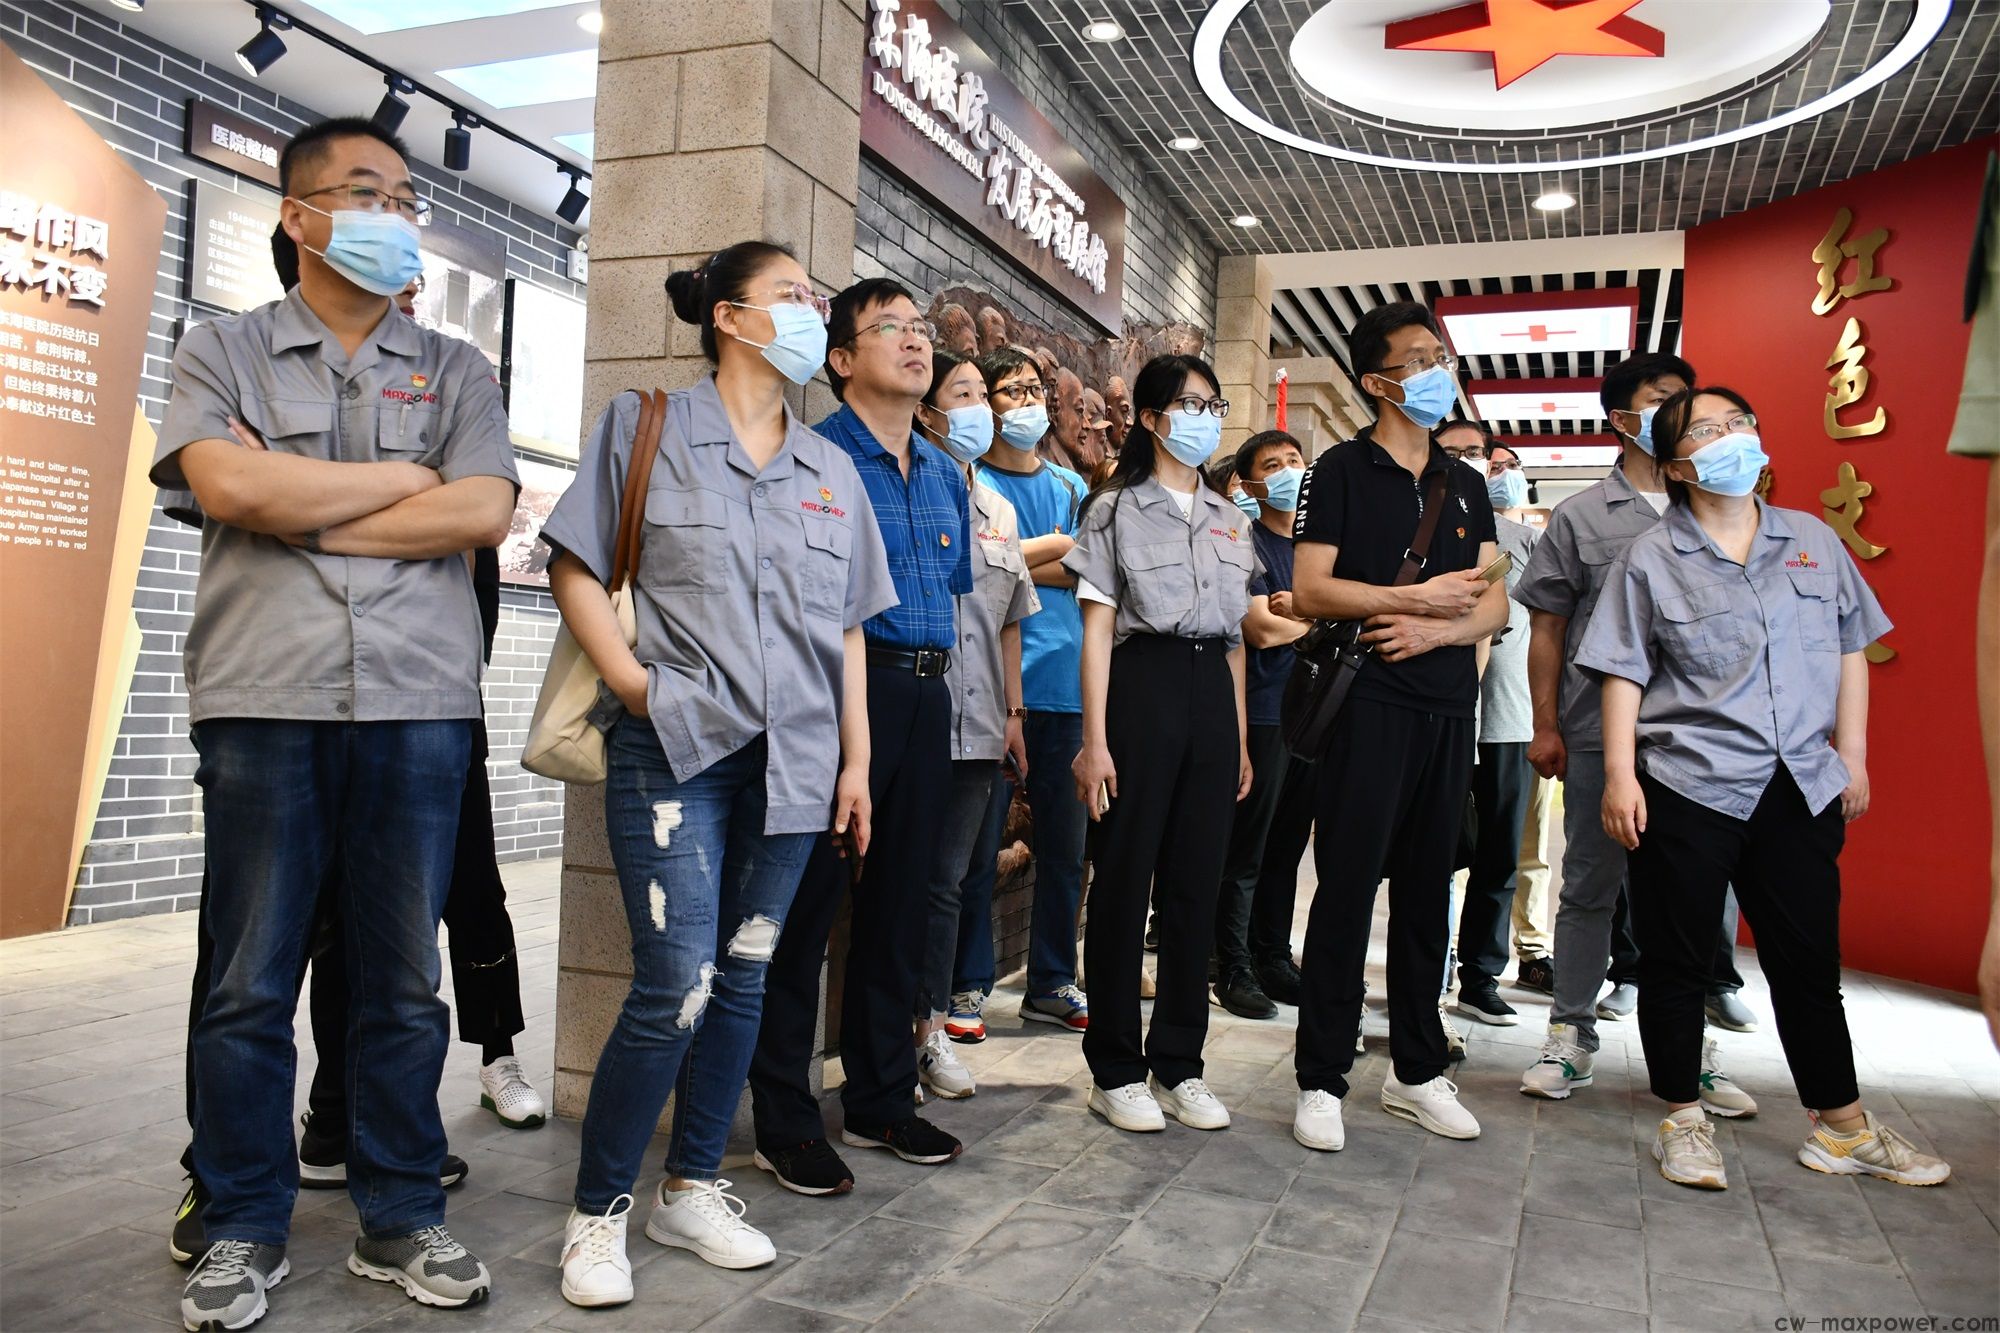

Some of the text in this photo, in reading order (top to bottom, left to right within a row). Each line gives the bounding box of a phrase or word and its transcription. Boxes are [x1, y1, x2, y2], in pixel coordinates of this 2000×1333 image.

[6, 455, 26, 467] hard
[28, 460, 45, 470] and
[10, 469, 28, 480] field
[30, 472, 61, 484] hospital
[63, 478, 82, 488] after
[42, 488, 57, 497] war
[59, 490, 75, 500] and
[77, 491, 90, 502] the
[17, 495, 47, 509] Nanma
[50, 500, 77, 514] Village
[80, 504, 89, 514] of
[30, 511, 45, 521] has
[46, 513, 88, 527] maintained
[18, 522, 40, 535] Army
[42, 525, 58, 536] and
[59, 528, 88, 538] worked
[14, 535, 42, 546] people
[57, 540, 70, 549] the
[73, 541, 87, 551] red
